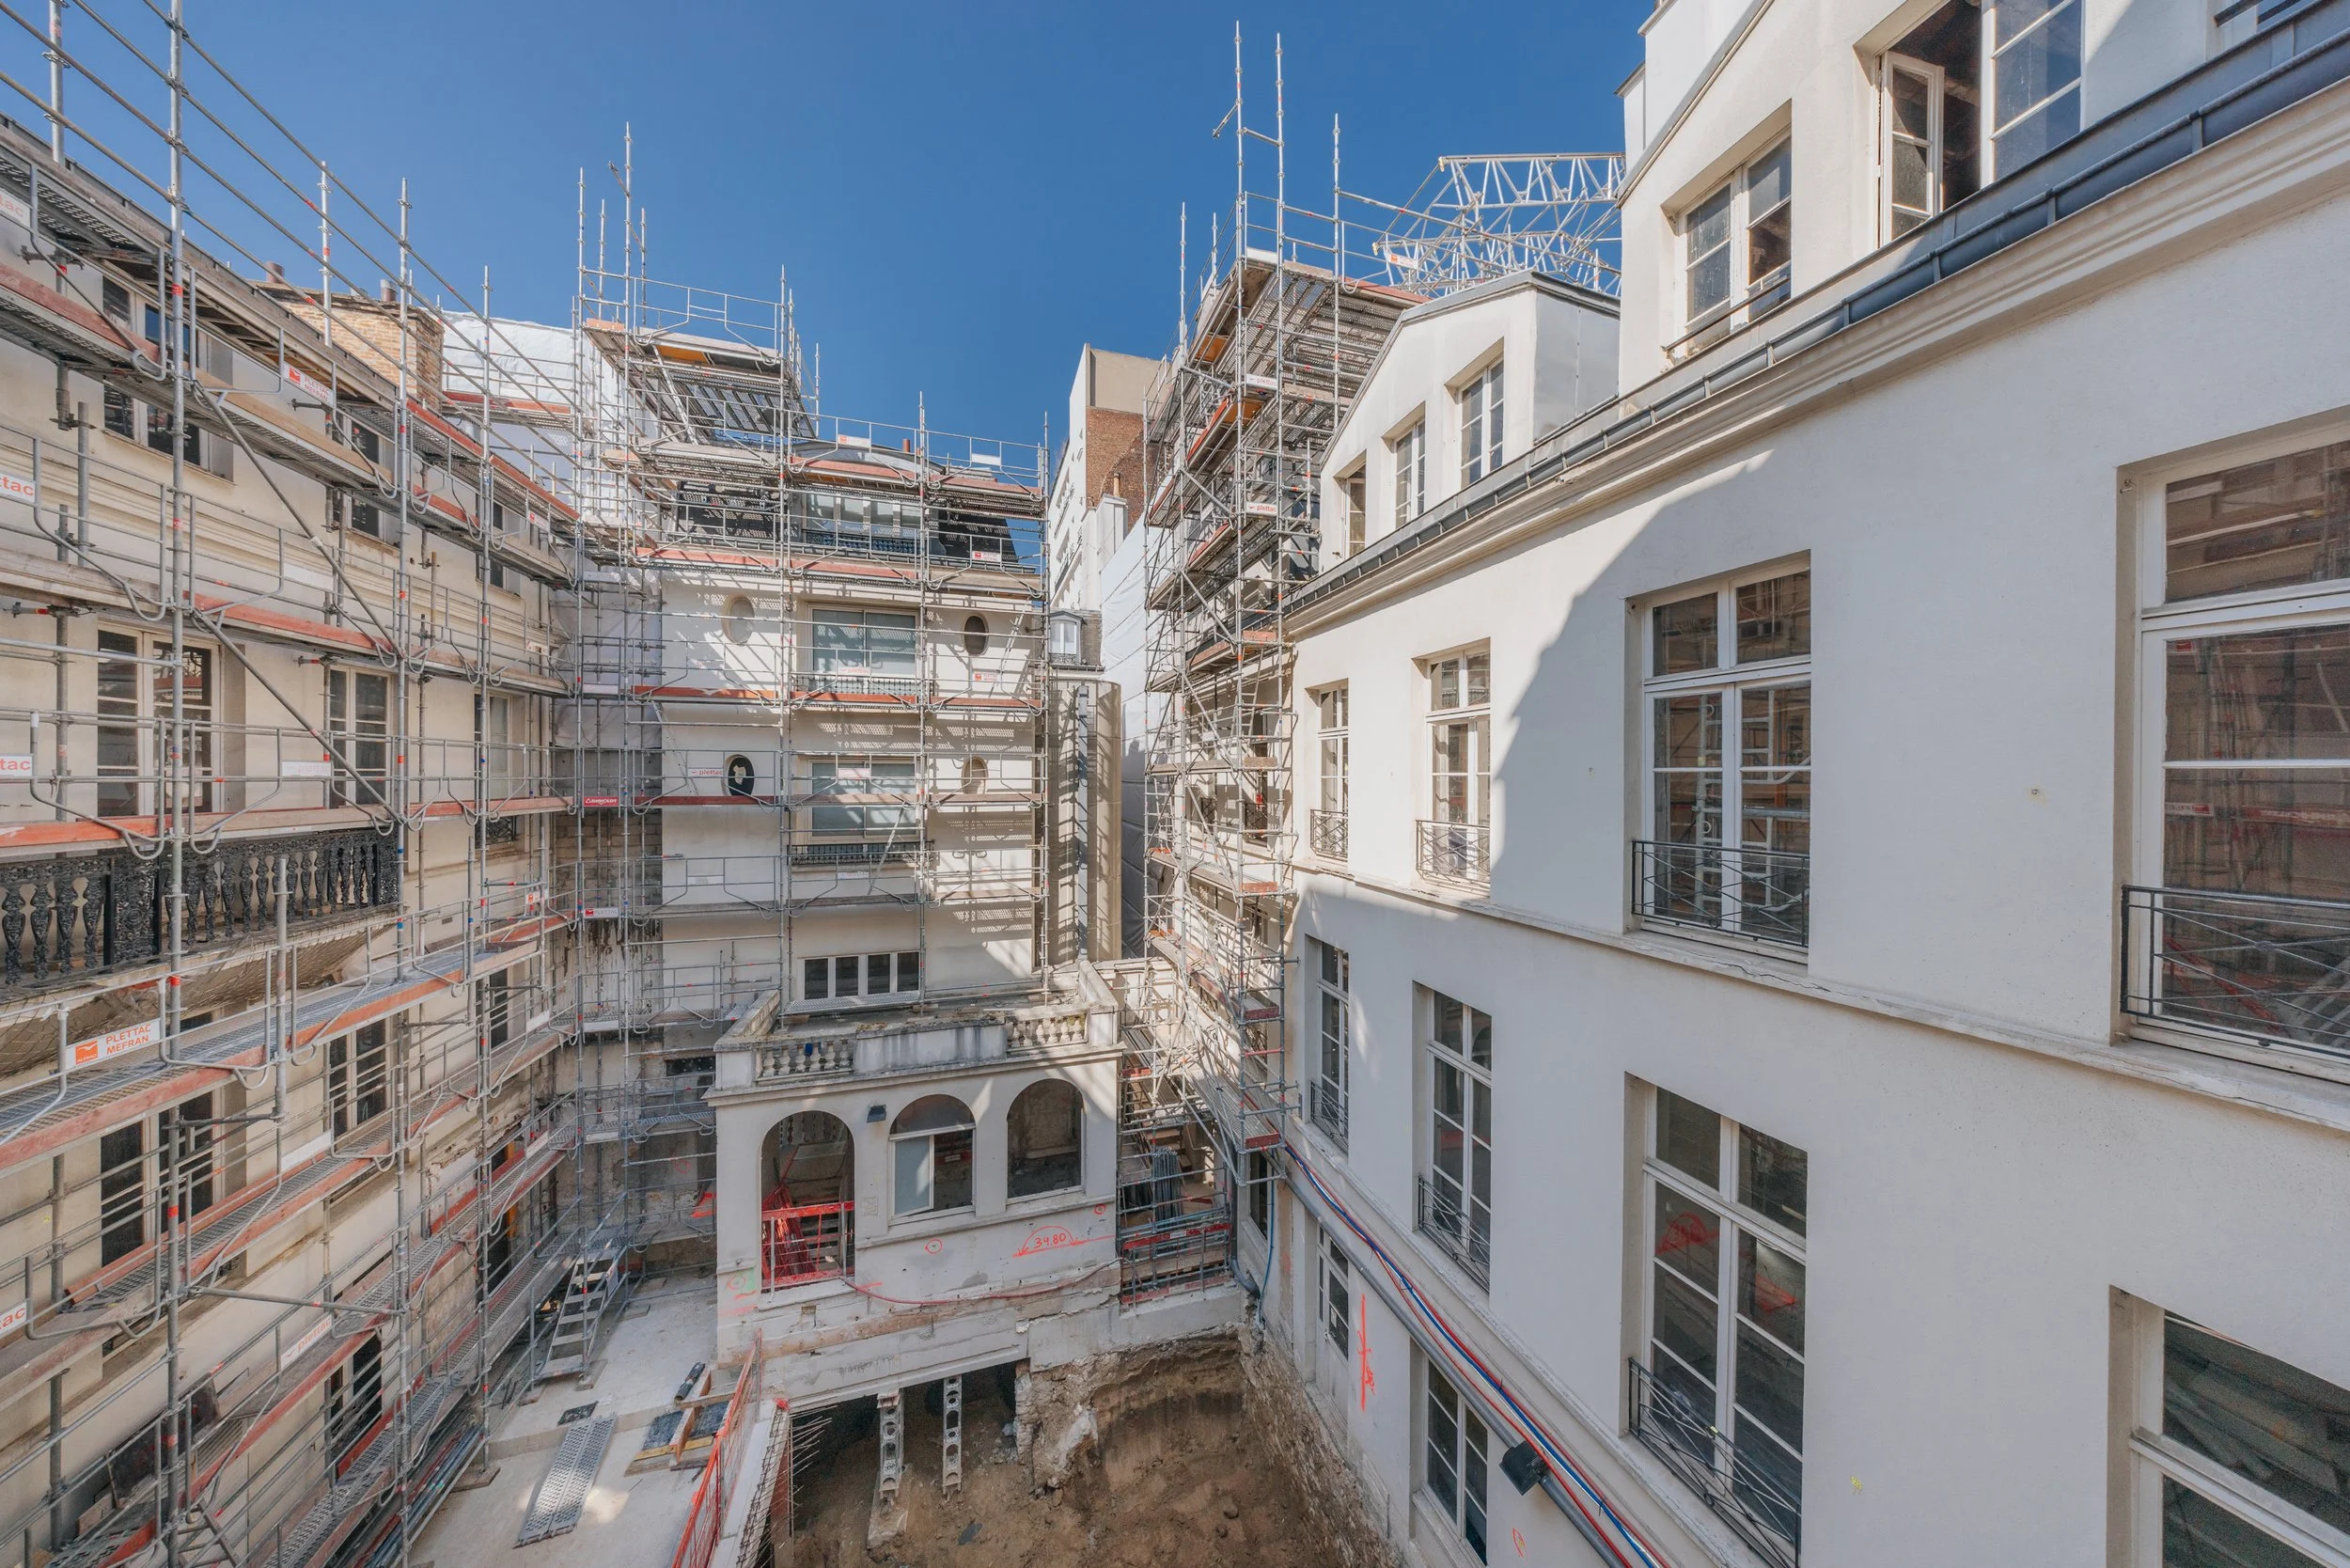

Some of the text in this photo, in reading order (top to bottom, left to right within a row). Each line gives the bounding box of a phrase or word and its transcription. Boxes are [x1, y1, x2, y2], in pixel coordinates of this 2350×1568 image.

[1257, 377, 1277, 386] plettac
[0, 475, 34, 496] tac
[1257, 503, 1277, 512] plettac
[105, 1024, 151, 1045] PLETTAC
[106, 1035, 149, 1055] MEFRAN
[298, 1319, 331, 1352] plettac
